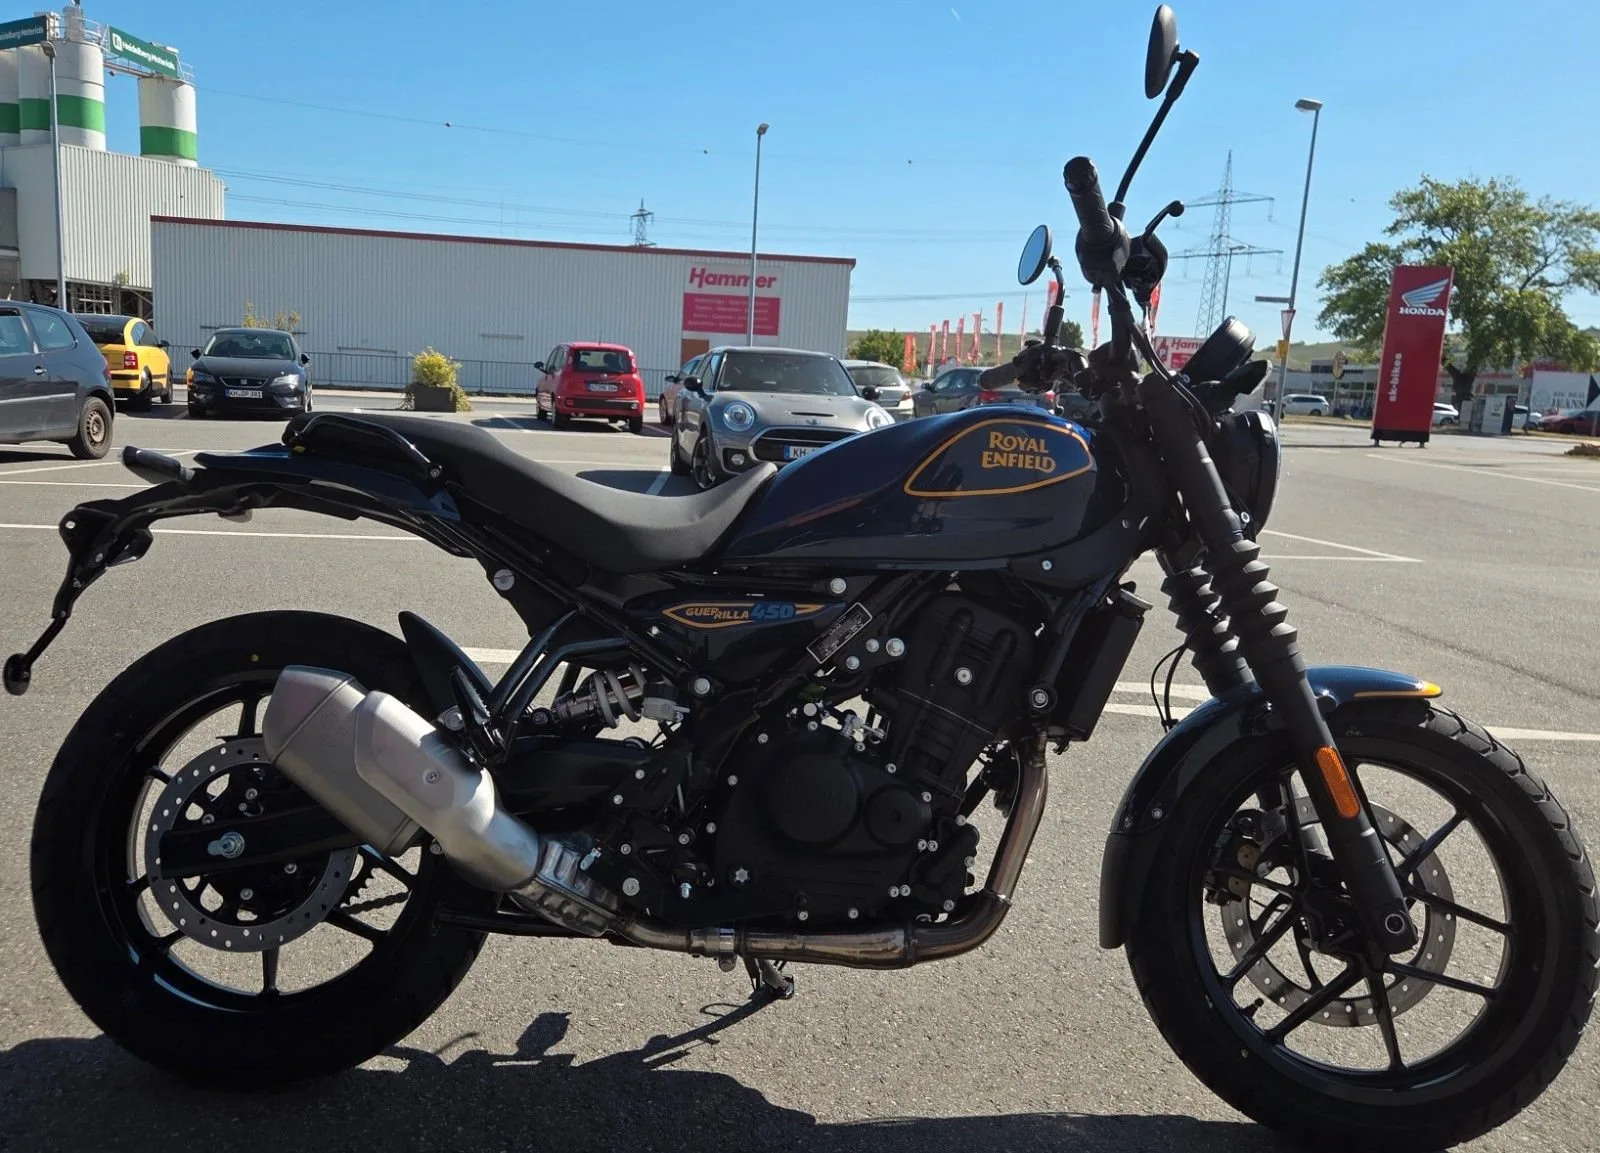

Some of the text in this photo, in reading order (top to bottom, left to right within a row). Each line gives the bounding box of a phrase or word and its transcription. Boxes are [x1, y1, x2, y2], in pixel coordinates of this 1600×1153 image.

[689, 267, 777, 288] Hammer
[1399, 307, 1445, 316] HONDA
[1170, 338, 1204, 350] Ham
[989, 431, 1049, 453] ROYAL
[981, 451, 1057, 474] ENFIELD
[685, 604, 795, 620] GUERRILLA 450
